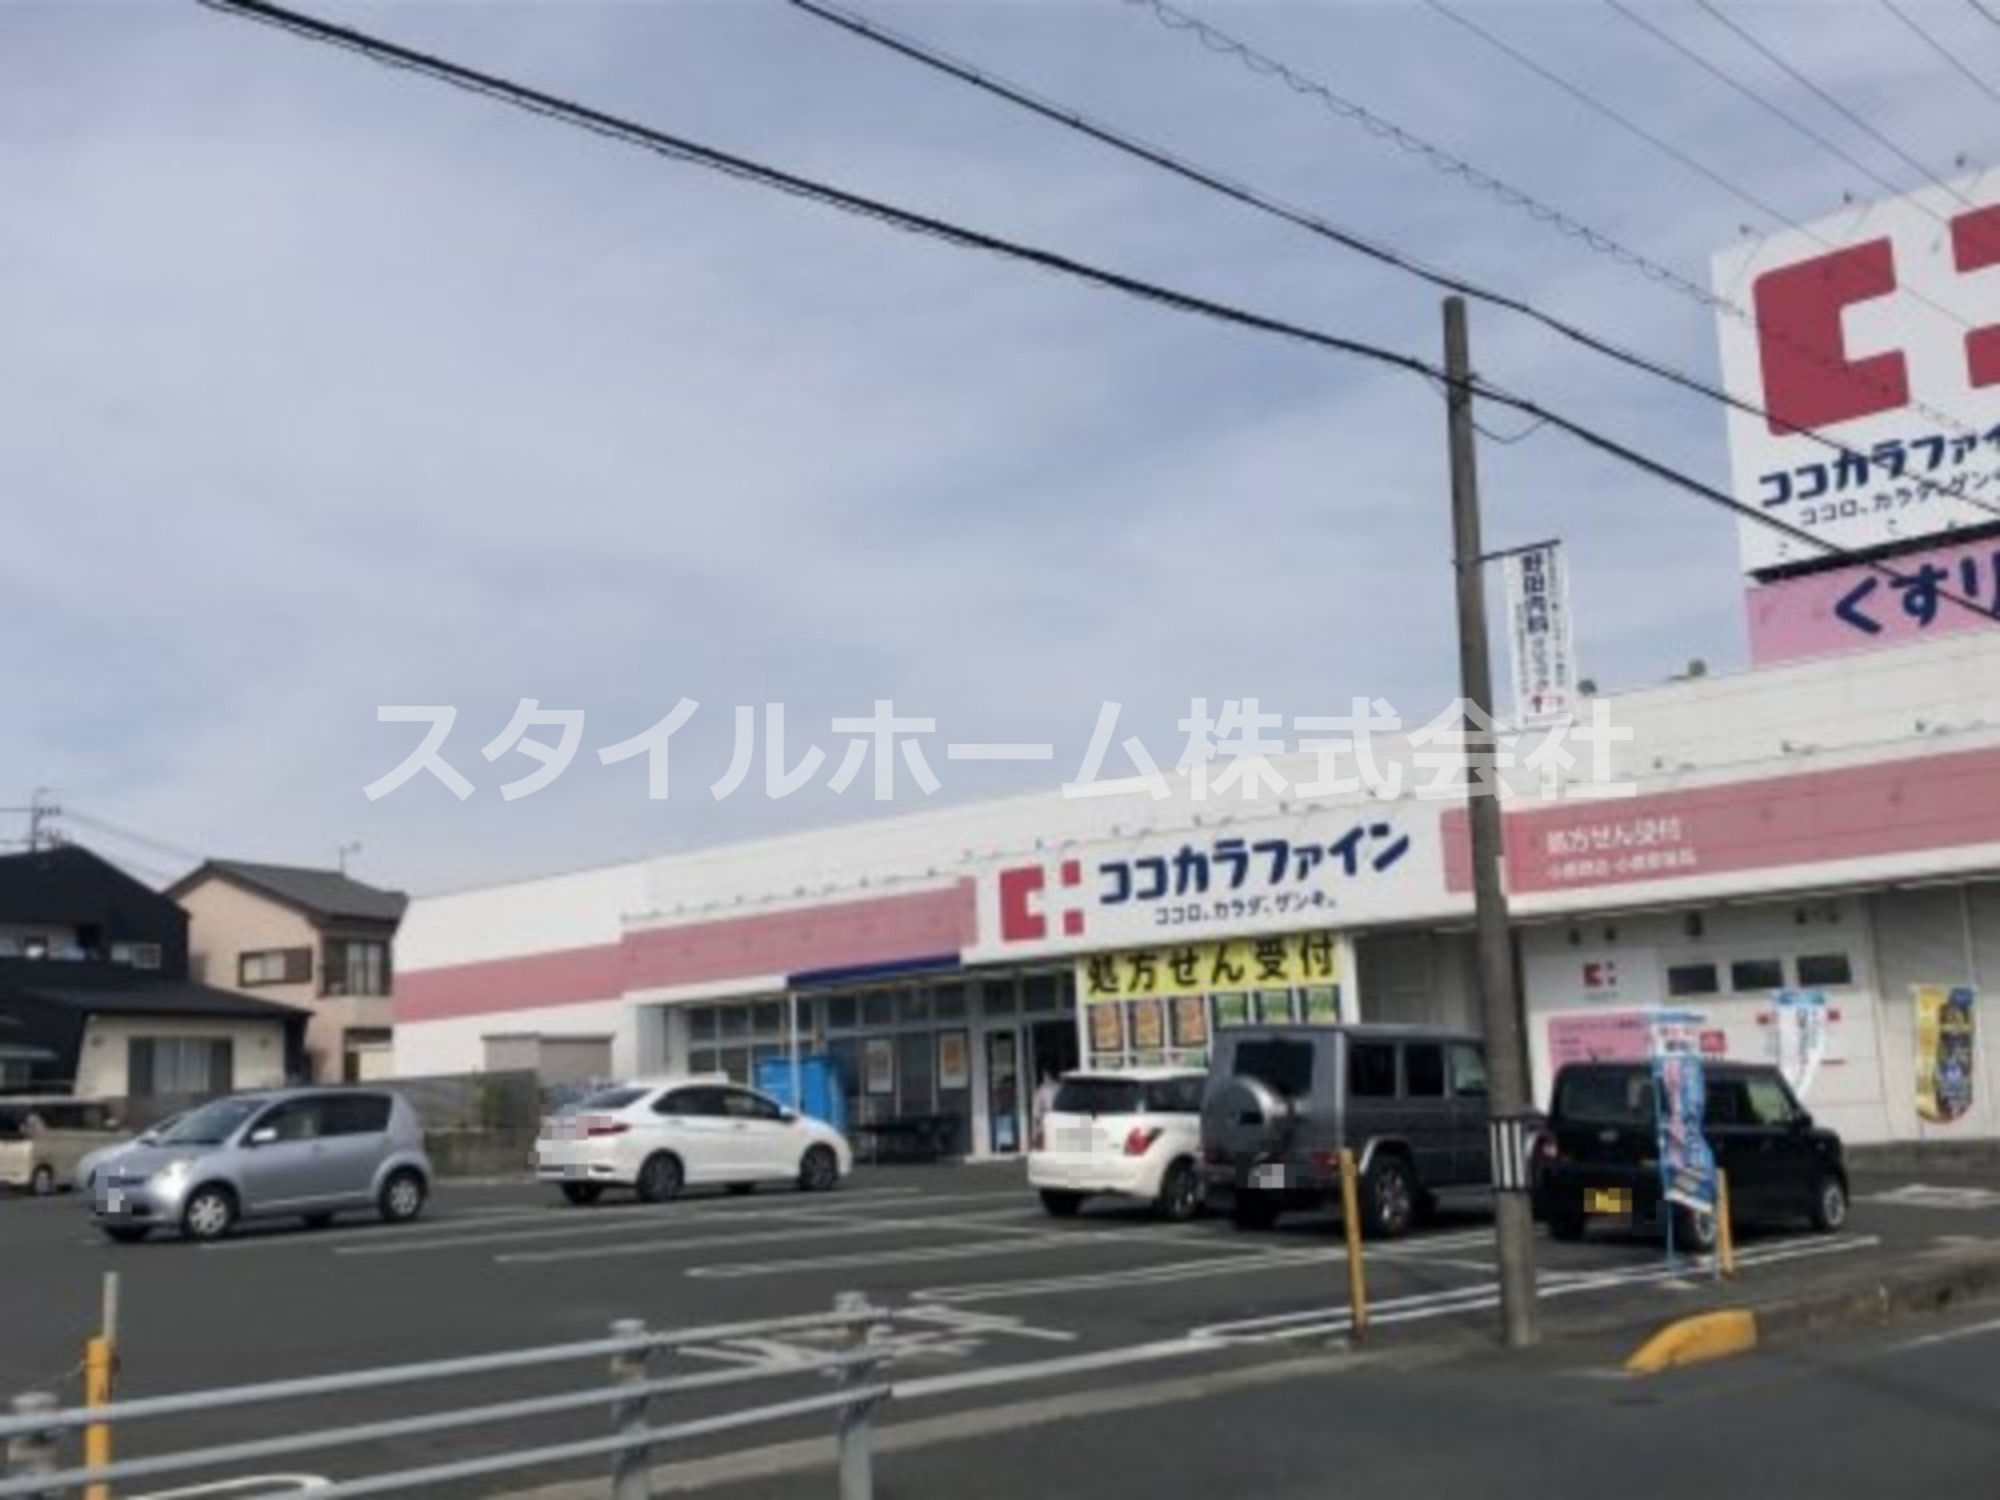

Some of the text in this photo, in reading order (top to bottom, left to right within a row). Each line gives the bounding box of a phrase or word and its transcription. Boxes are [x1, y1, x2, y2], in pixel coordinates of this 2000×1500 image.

[1835, 550, 2000, 635] くすり
[1098, 822, 1410, 905] ココカラファイン
[1086, 934, 1336, 995] 処方せん受付
